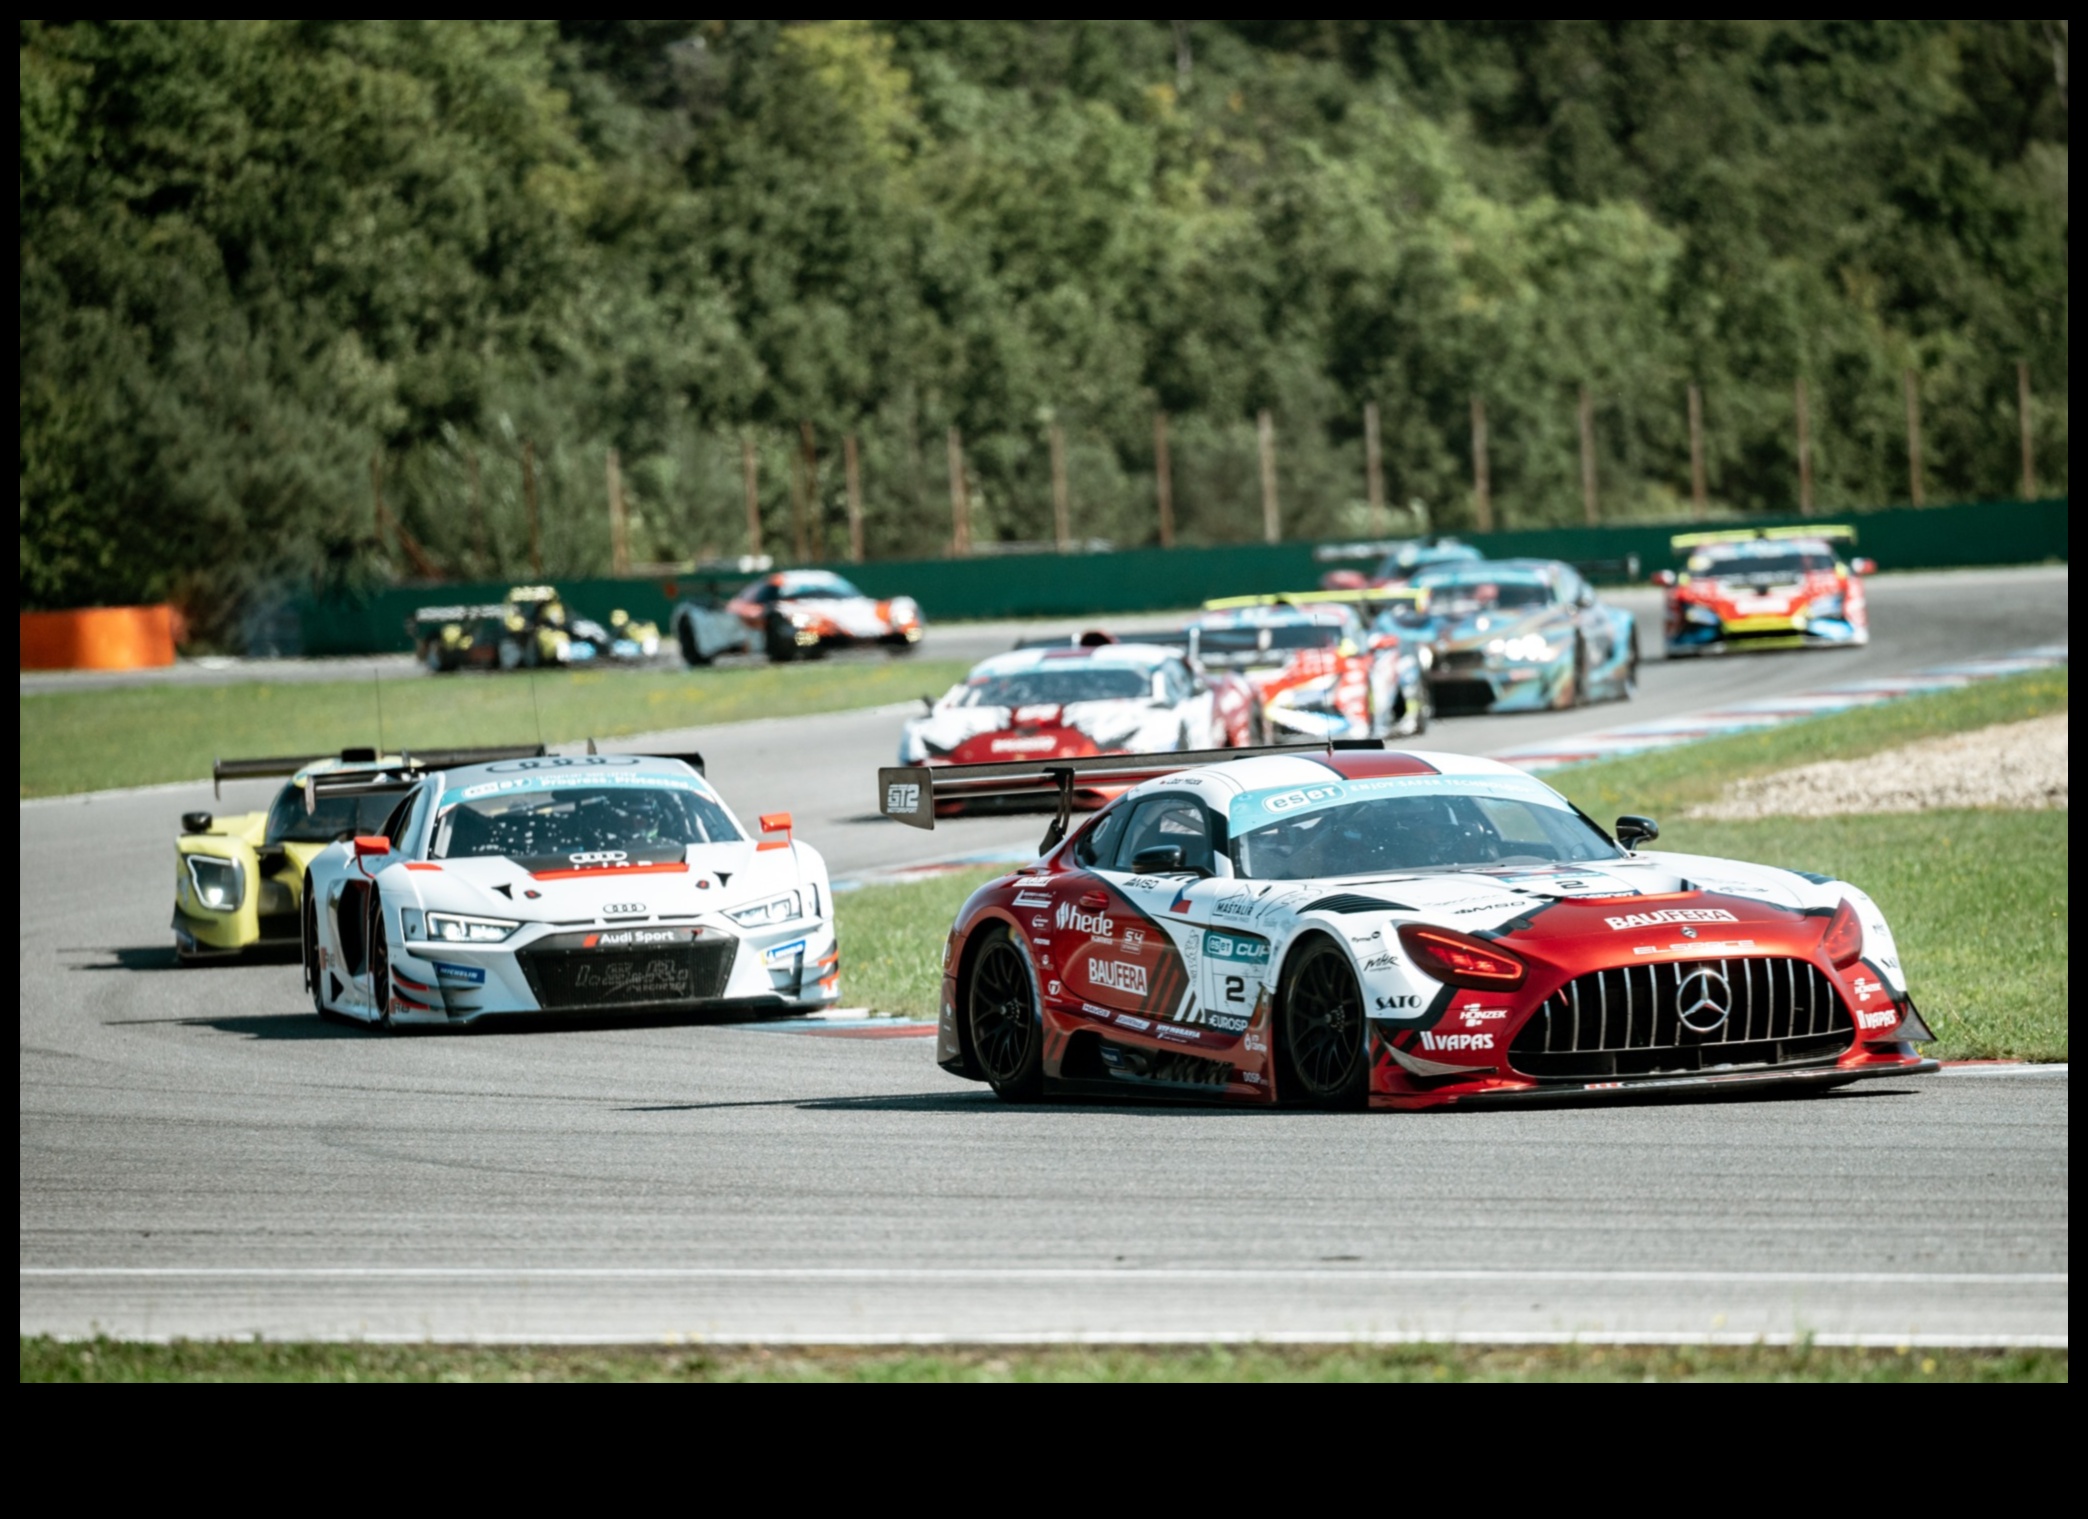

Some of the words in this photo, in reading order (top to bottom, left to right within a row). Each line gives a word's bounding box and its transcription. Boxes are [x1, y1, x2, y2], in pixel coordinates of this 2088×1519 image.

[1351, 781, 1394, 791] ENJOY
[1399, 778, 1440, 788] SAFER
[887, 784, 919, 807] GT2
[1555, 880, 1590, 889] 2
[1604, 909, 1738, 930] BAUFERA
[600, 931, 632, 944] Audi
[635, 931, 674, 944] Sport
[1236, 943, 1270, 957] CUP
[440, 968, 478, 979] MICHELIN
[1089, 958, 1147, 995] BAUFERA
[1225, 975, 1245, 1003] 2
[1375, 995, 1421, 1010] SATO
[1459, 1010, 1507, 1020] HONZEK
[1435, 1033, 1494, 1051] VAPAS
